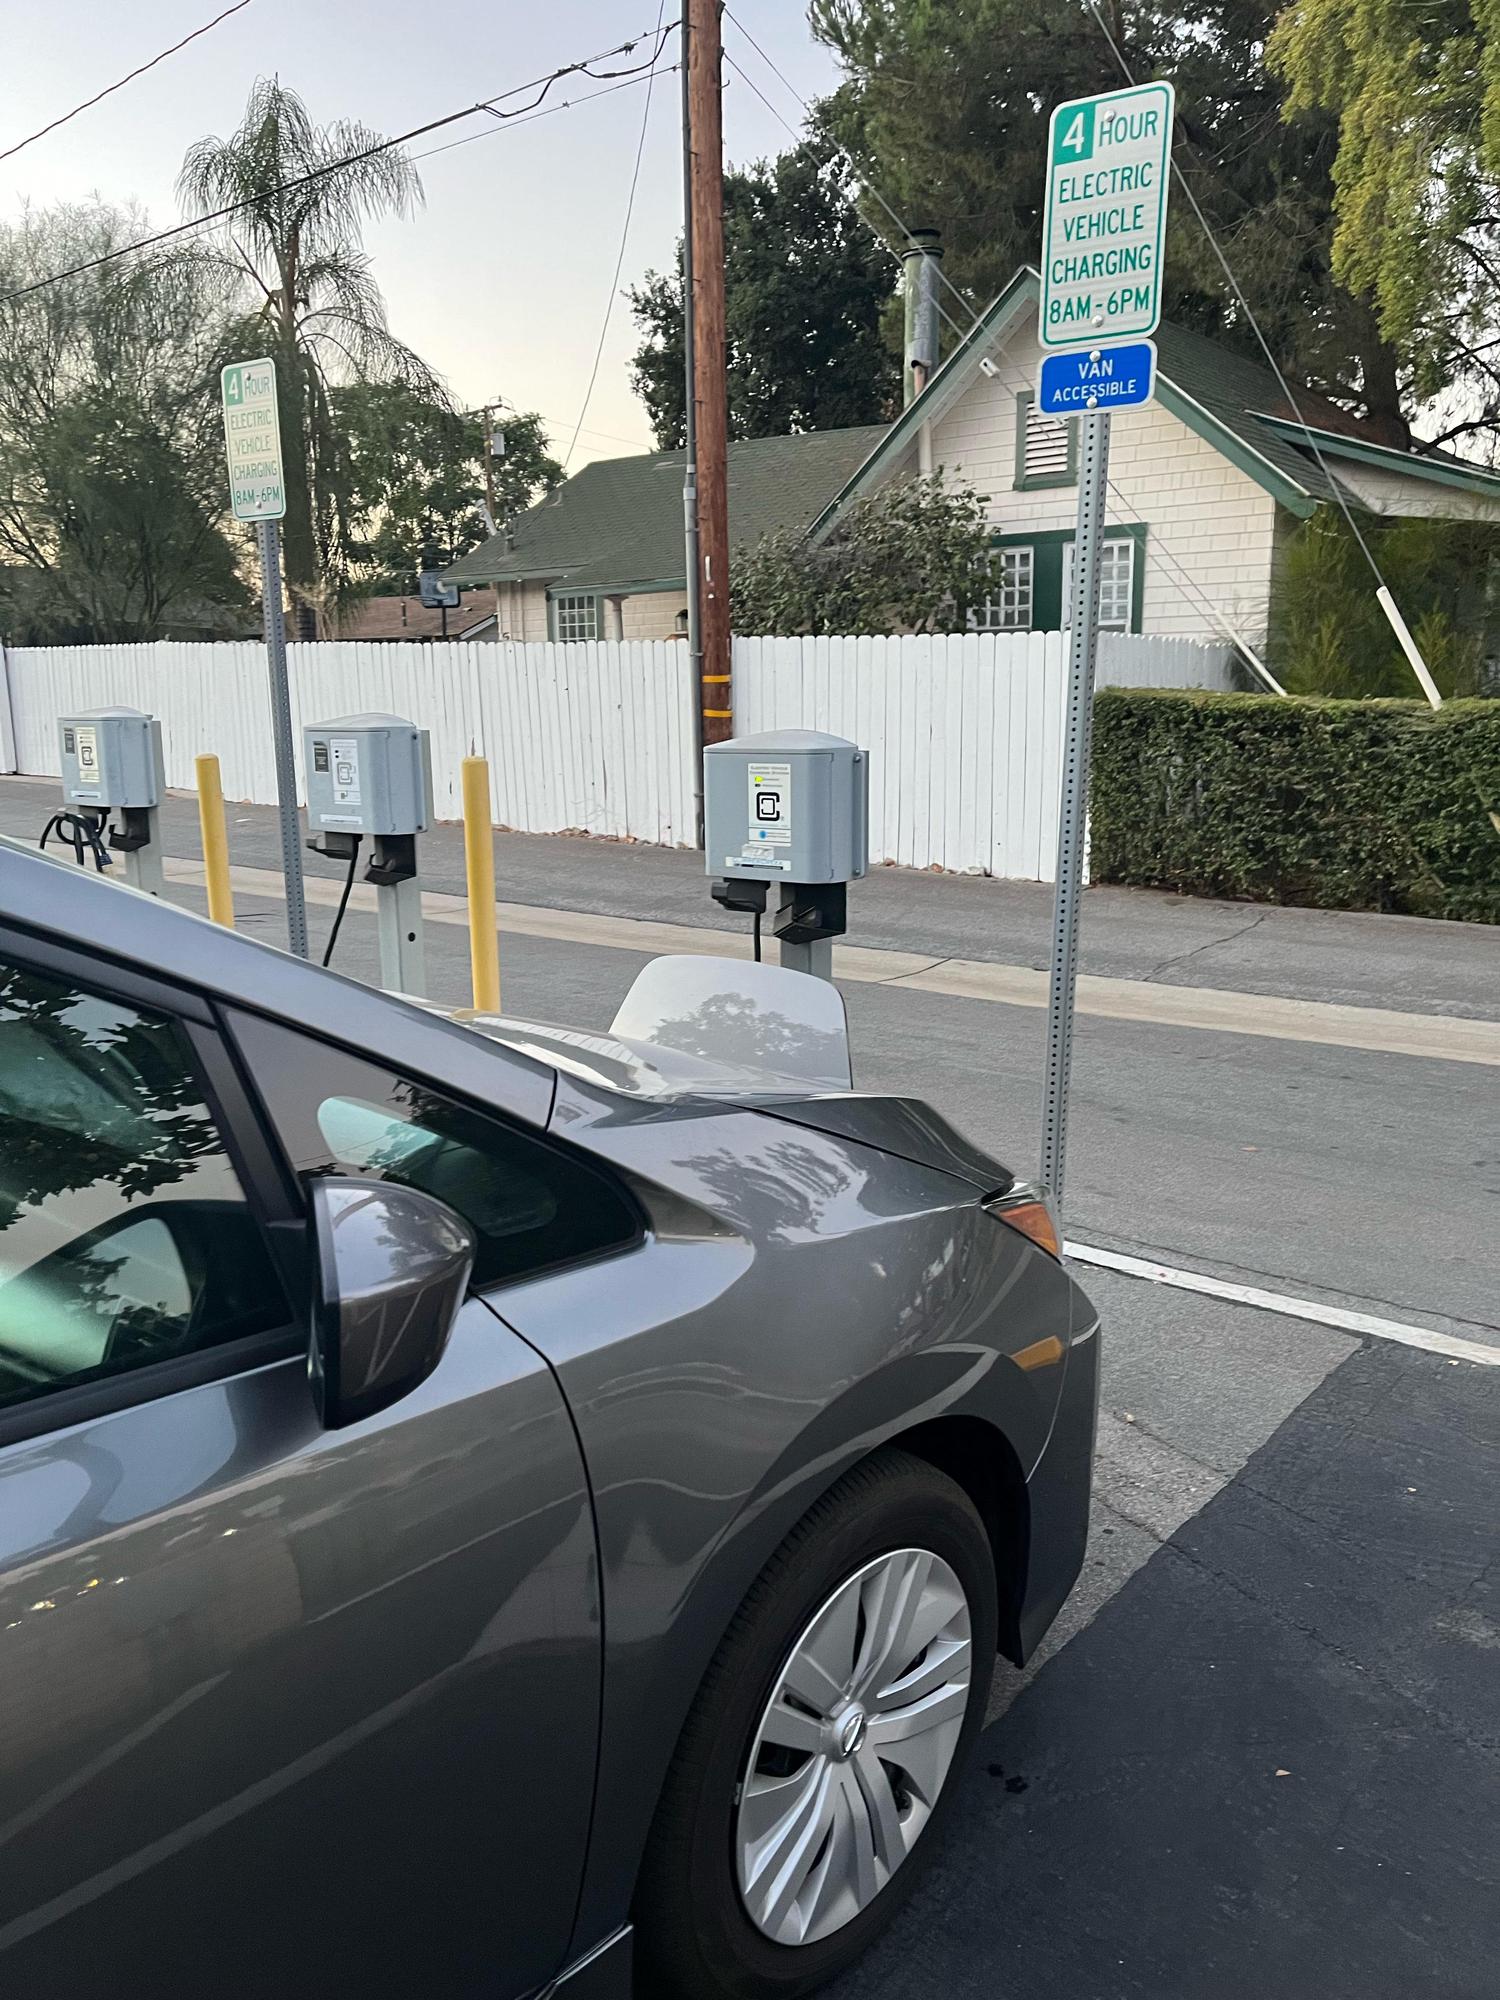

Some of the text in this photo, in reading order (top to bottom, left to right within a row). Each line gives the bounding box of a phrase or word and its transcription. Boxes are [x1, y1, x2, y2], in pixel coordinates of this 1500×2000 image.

[1061, 110, 1158, 154] 4 HOUR
[1059, 163, 1152, 203] ELECTRIC
[1063, 204, 1144, 242] VEHICLE
[1052, 244, 1151, 285] CHARGING
[1078, 358, 1113, 379] VAN
[228, 373, 270, 400] 4 HOUR
[1052, 379, 1137, 403] ACCESSIBLE
[231, 409, 271, 430] ELECTRIC
[235, 436, 271, 456] VEHICLE
[234, 461, 277, 480] CHARGING
